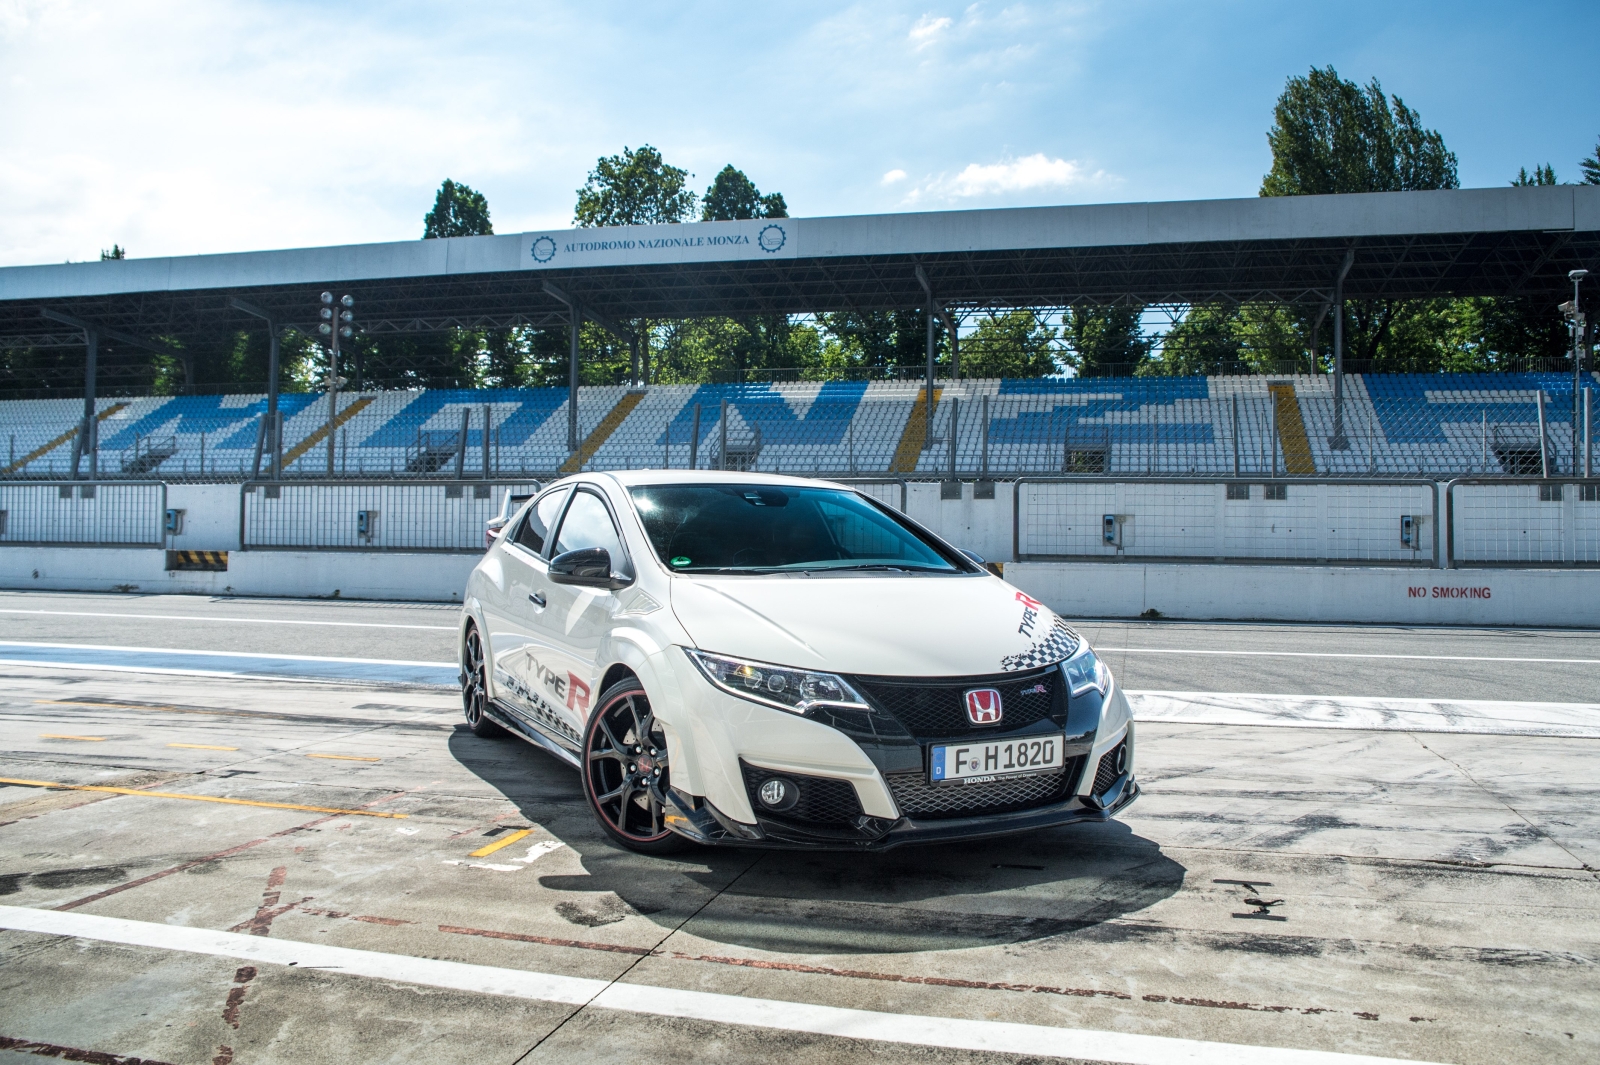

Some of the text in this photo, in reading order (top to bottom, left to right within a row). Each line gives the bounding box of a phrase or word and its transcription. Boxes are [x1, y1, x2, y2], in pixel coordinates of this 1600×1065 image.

[563, 235, 750, 253] AUTODROMO NAZIONALE MONZA
[1408, 586, 1492, 599] NO SMOKING
[935, 766, 941, 775] D
[963, 775, 997, 785] HONDA
